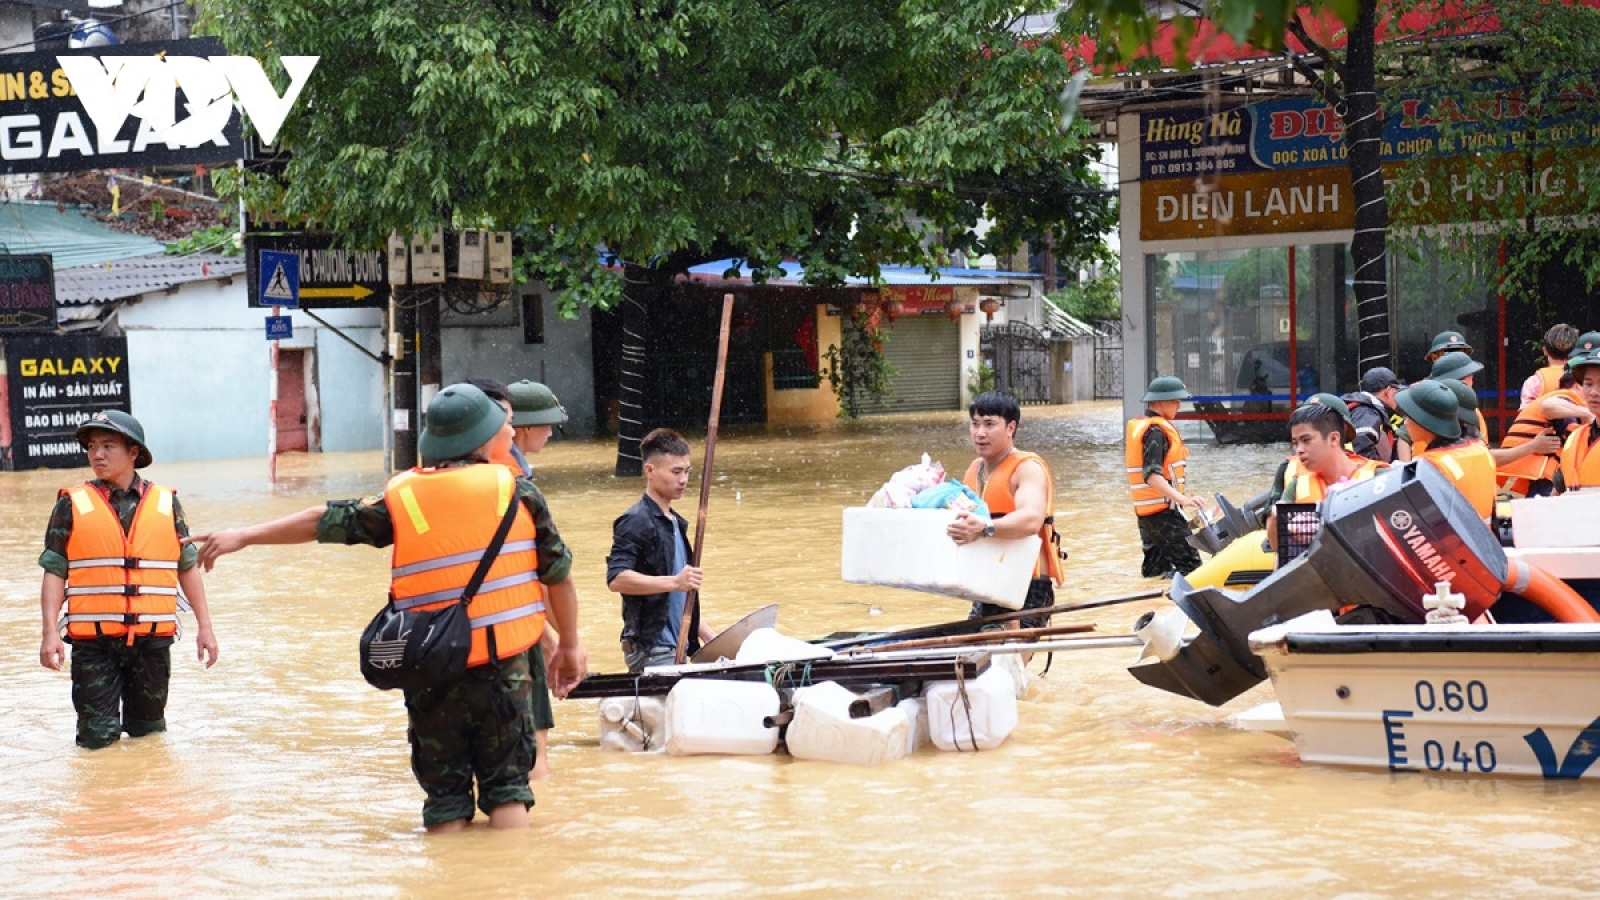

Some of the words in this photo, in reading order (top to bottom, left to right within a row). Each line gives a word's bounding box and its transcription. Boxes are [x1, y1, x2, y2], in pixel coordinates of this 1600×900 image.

[29, 71, 48, 97] &
[1146, 117, 1204, 144] Hùng
[1209, 110, 1243, 138] Hà
[1168, 162, 1193, 173] 0913
[1156, 179, 1235, 229] ĐIỆN
[1244, 183, 1340, 226] LẠNH
[20, 356, 122, 377] GALAXY
[24, 386, 37, 400] IN
[39, 382, 57, 399] ẤN
[66, 381, 90, 397] SẢN
[92, 380, 123, 397] XUẤT
[25, 414, 49, 429] BAO
[51, 411, 64, 428] BÌ
[28, 443, 41, 457] IN
[42, 441, 81, 456] NHANH
[1403, 525, 1457, 582] YAMAHA
[1415, 680, 1489, 712] 0.60
[1423, 740, 1497, 773] 0.40
